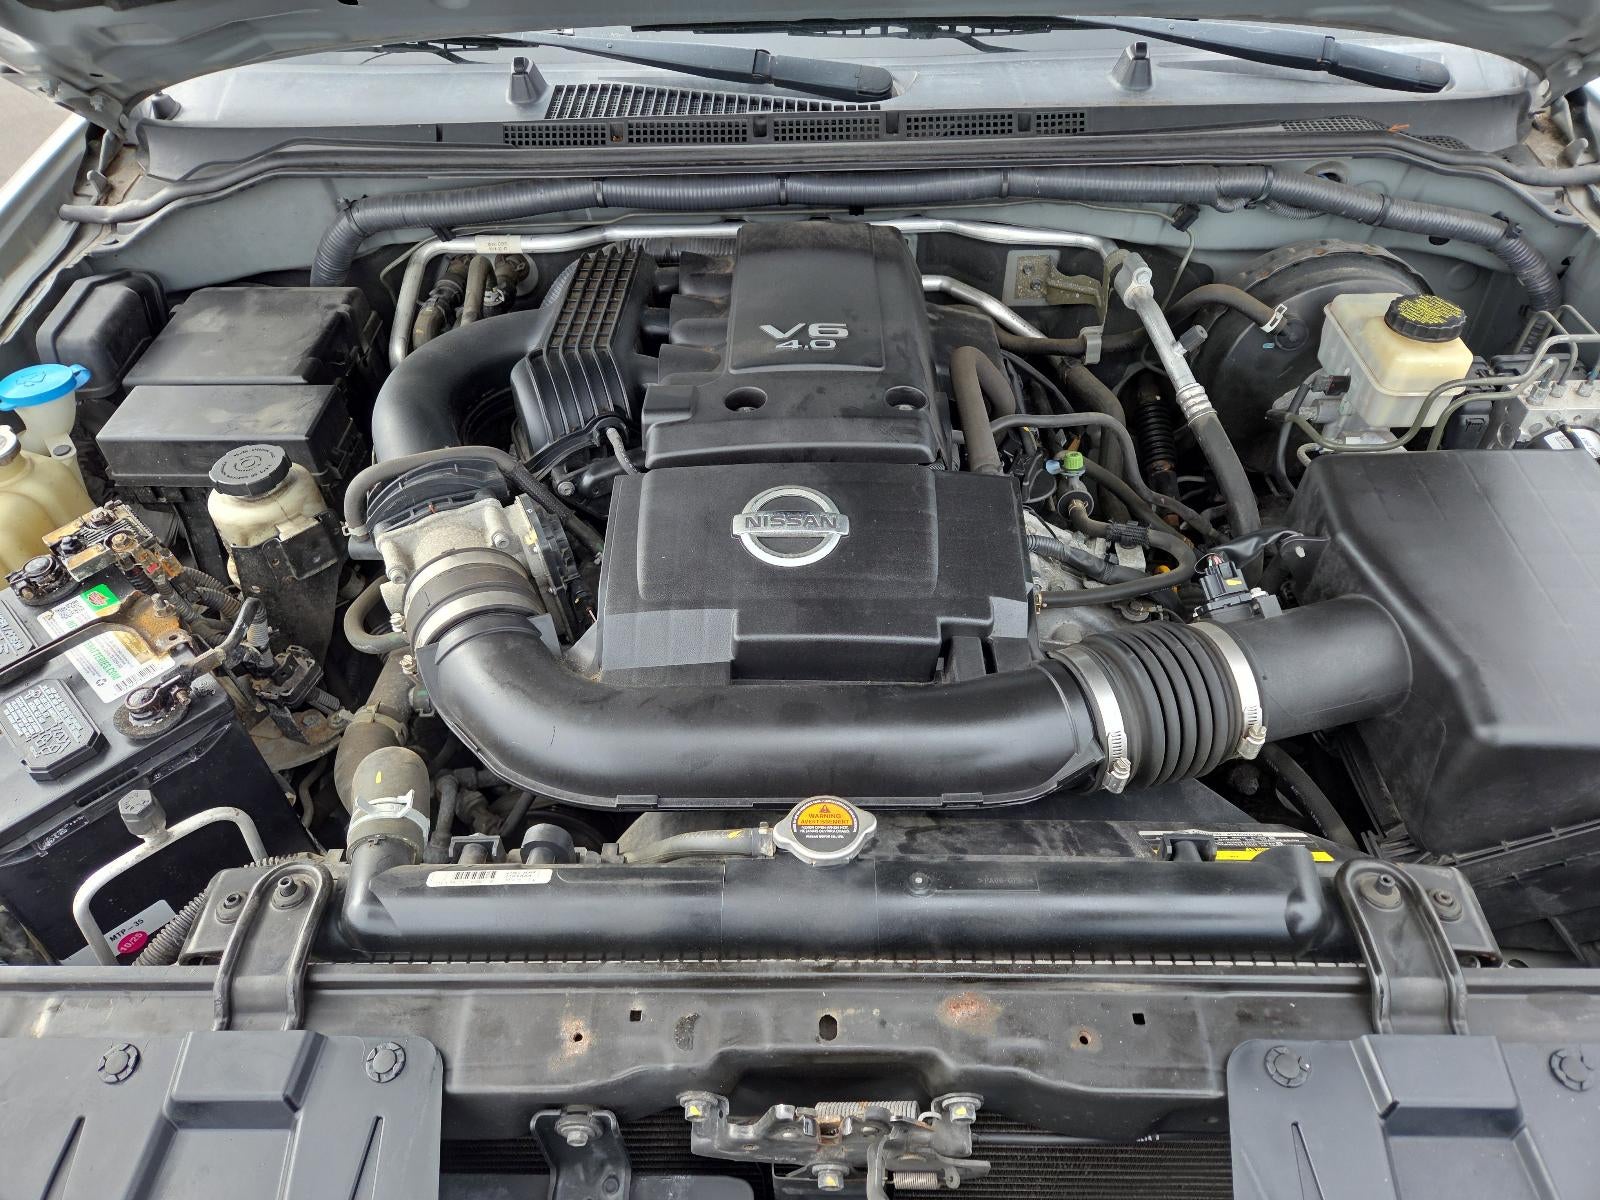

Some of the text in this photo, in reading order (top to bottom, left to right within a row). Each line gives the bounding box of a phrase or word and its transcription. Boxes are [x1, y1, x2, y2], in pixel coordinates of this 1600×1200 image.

[759, 322, 849, 339] V6
[775, 339, 837, 351] 4.0
[744, 514, 838, 529] NISSAN
[110, 928, 126, 942] MTP
